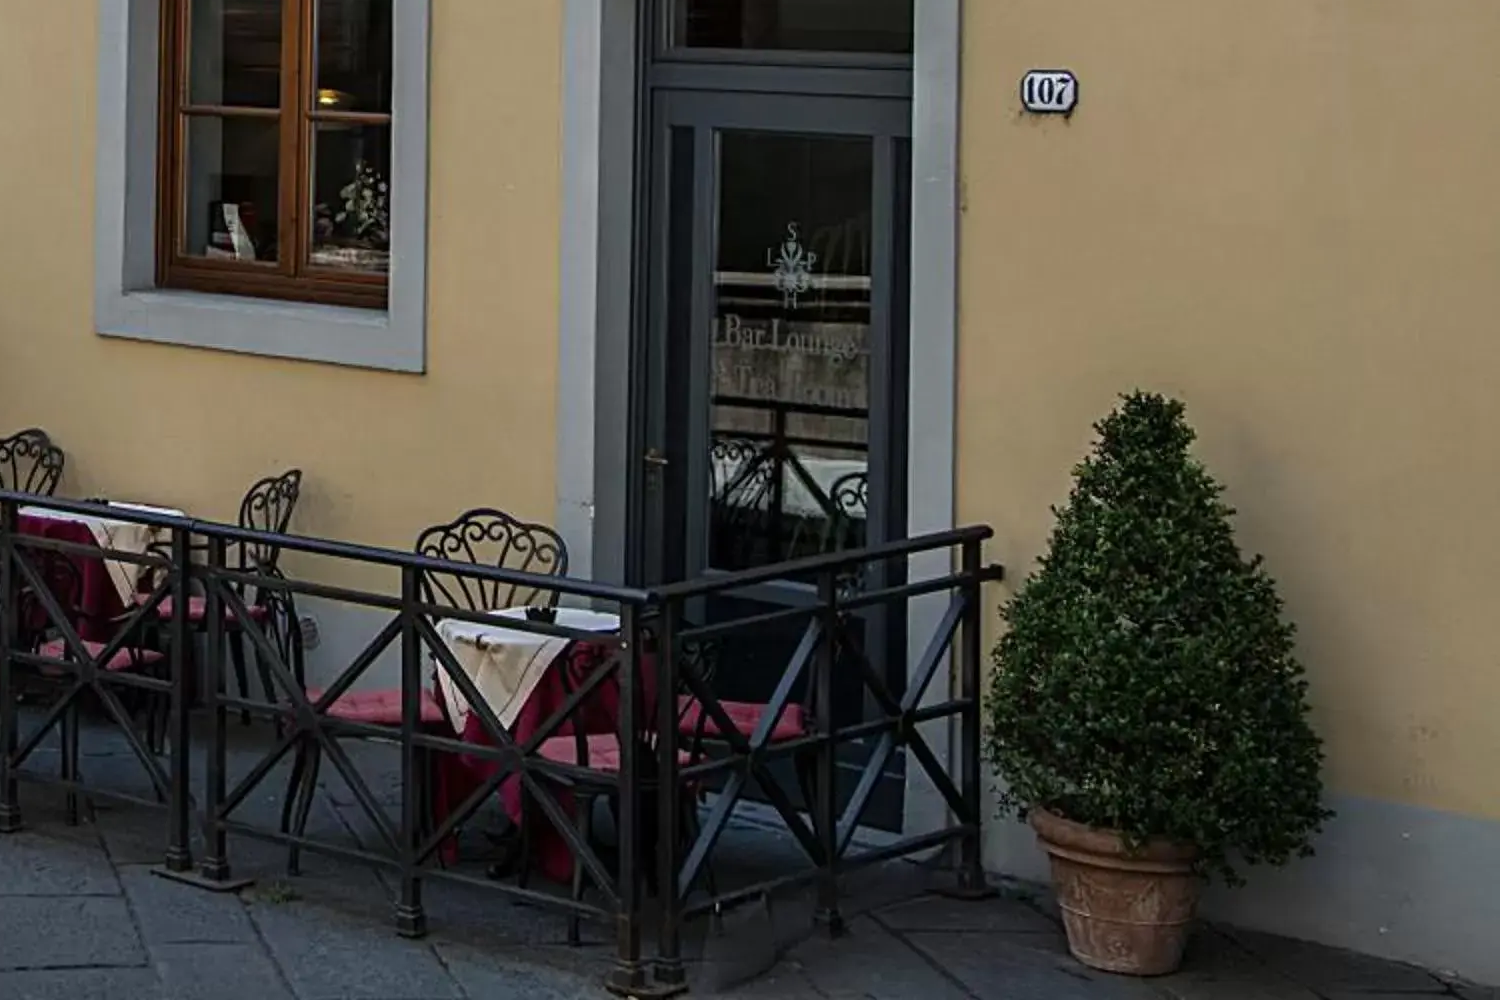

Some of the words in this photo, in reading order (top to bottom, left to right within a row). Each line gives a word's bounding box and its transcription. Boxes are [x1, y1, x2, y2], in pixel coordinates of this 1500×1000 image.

[1027, 76, 1071, 105] 107
[724, 313, 766, 351] Bar
[770, 318, 860, 368] Lounge
